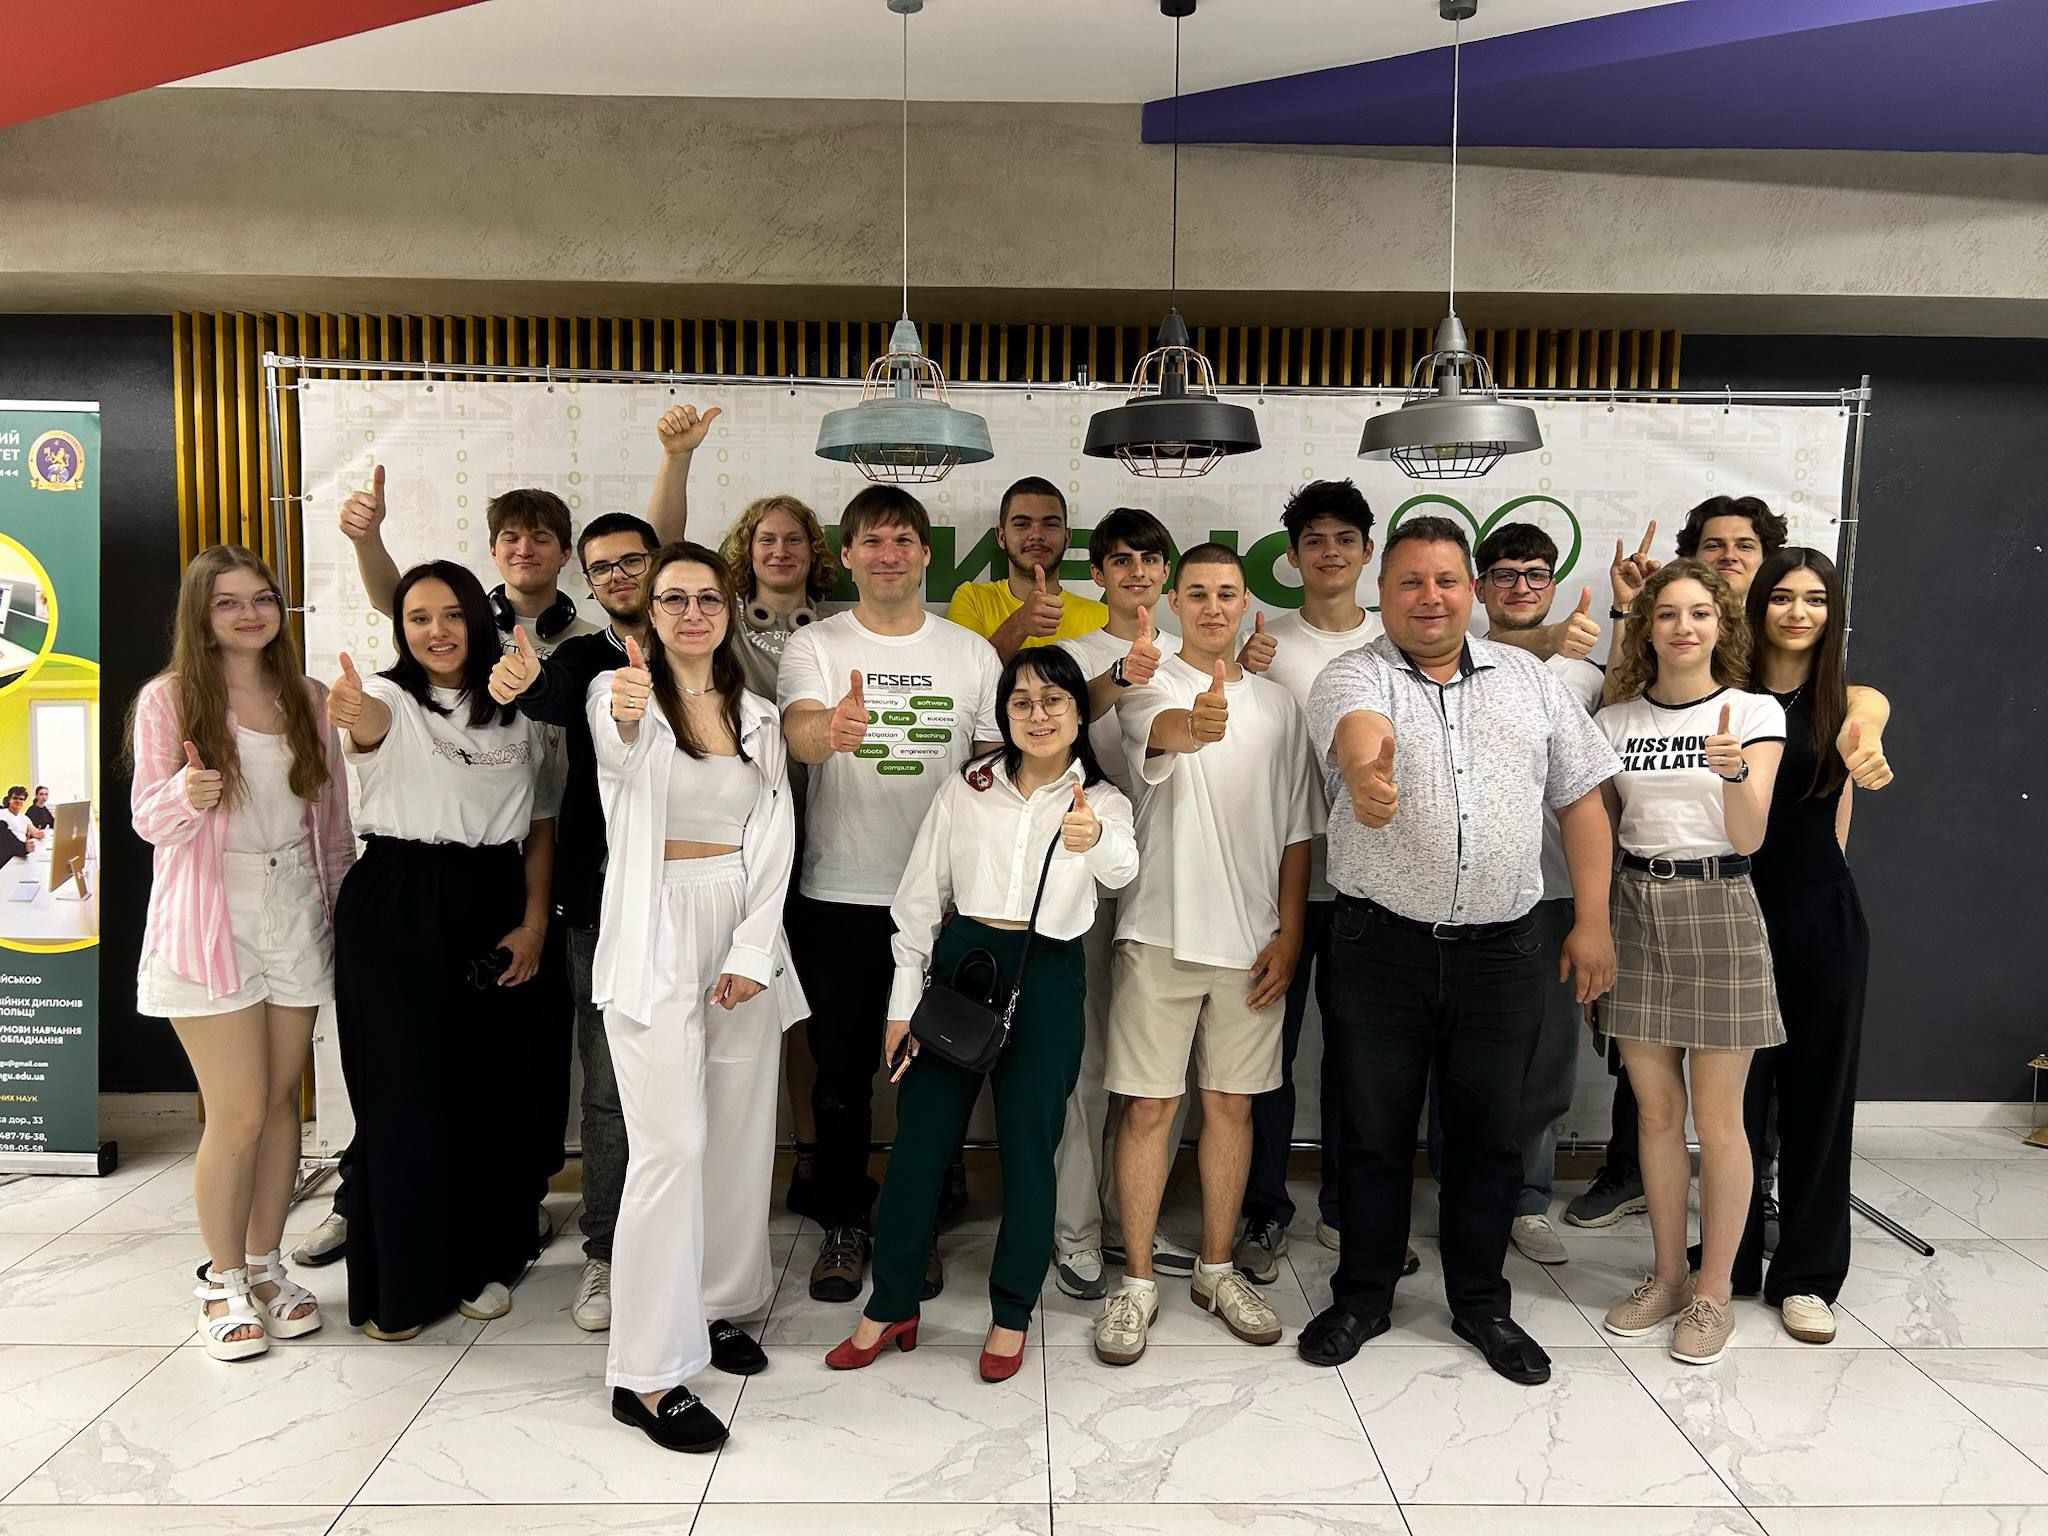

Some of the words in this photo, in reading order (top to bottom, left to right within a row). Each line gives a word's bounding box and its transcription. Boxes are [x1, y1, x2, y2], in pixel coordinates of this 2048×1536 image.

[867, 673, 932, 687] FCSECS
[864, 698, 899, 706] ersecurity
[915, 732, 946, 740] teaching
[1625, 737, 1669, 754] KISS
[900, 748, 939, 756] engineering
[1620, 755, 1657, 772] ALK
[1660, 753, 1710, 770] LATE
[883, 764, 917, 772] computer
[31, 998, 83, 1009] ДИПЛОМІВ
[32, 1026, 82, 1035] НАВЧАННЯ
[0, 1035, 64, 1045] ОБЛАДНАННЯ
[16, 1095, 38, 1103] НАУК
[8, 1116, 32, 1126] дор.,
[32, 1116, 44, 1125] 33
